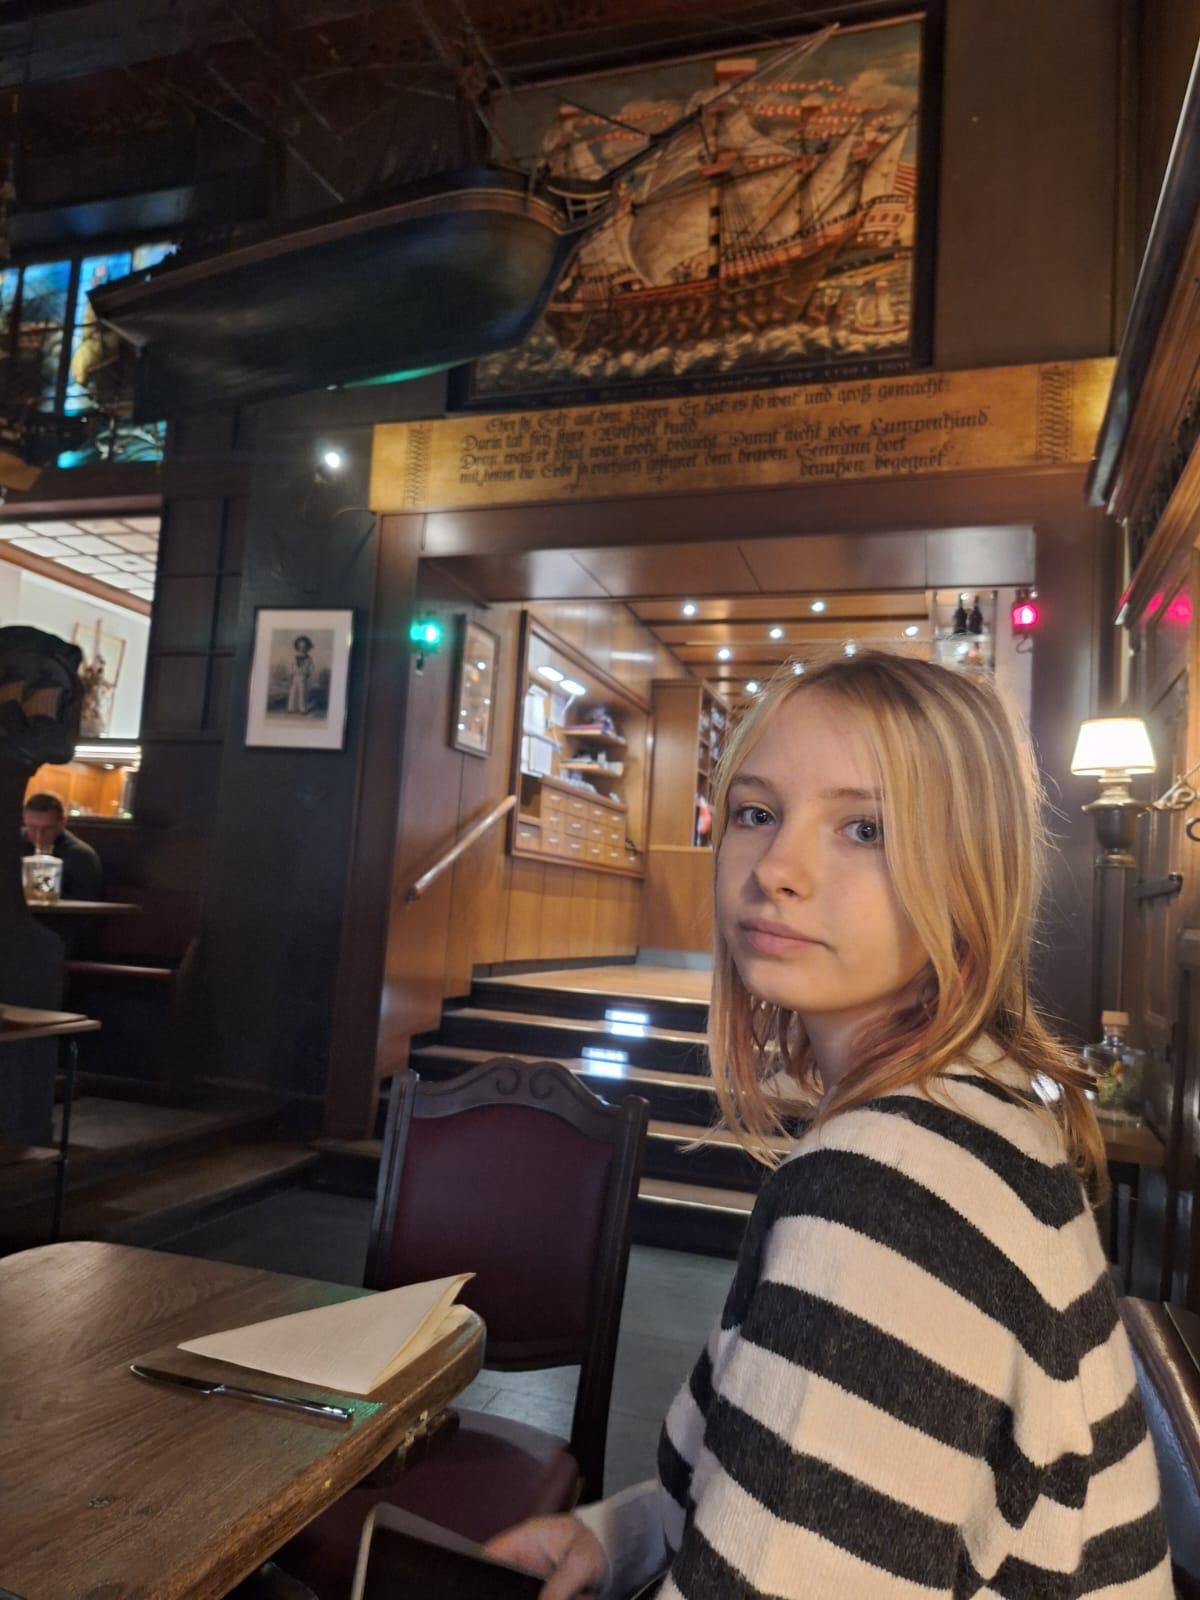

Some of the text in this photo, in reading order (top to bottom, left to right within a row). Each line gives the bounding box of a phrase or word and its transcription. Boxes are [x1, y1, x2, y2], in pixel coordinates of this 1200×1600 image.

[804, 386, 832, 405] und
[838, 383, 872, 404] groß
[783, 419, 820, 440] nicht
[828, 418, 861, 441] jeder
